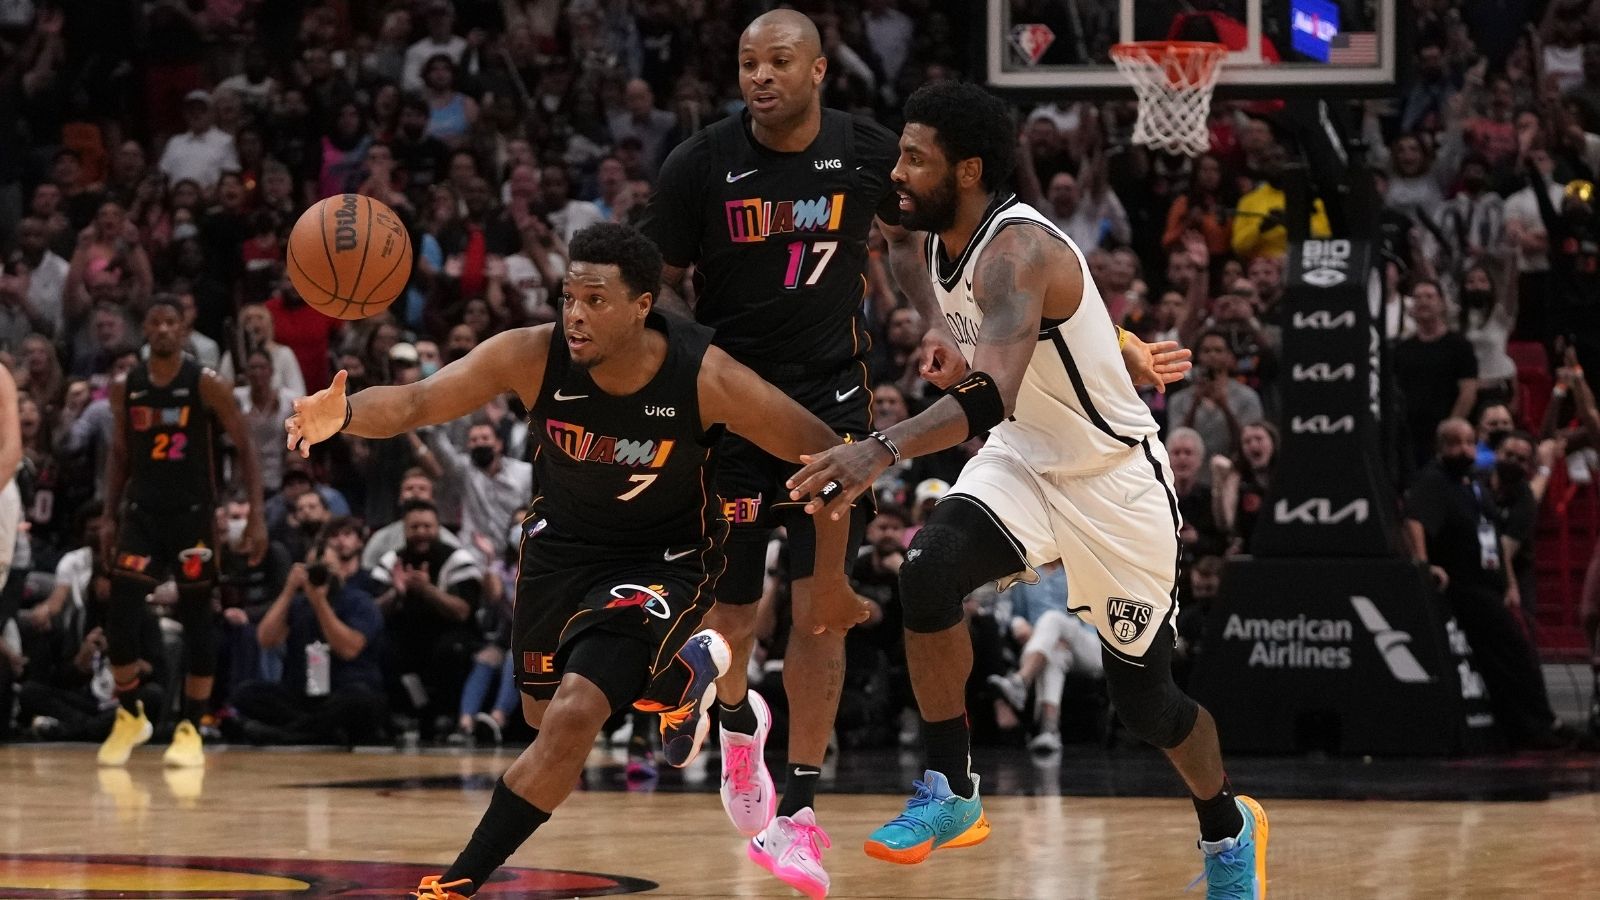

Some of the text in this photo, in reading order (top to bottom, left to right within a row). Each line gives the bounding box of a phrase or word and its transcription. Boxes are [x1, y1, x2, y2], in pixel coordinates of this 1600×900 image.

[784, 240, 838, 290] 17
[150, 432, 187, 460] 22
[617, 474, 658, 501] 7
[722, 498, 762, 523] EAT
[1109, 600, 1150, 625] NETS
[1223, 613, 1353, 641] American
[524, 651, 554, 674] HE
[1248, 641, 1352, 669] Airlines
